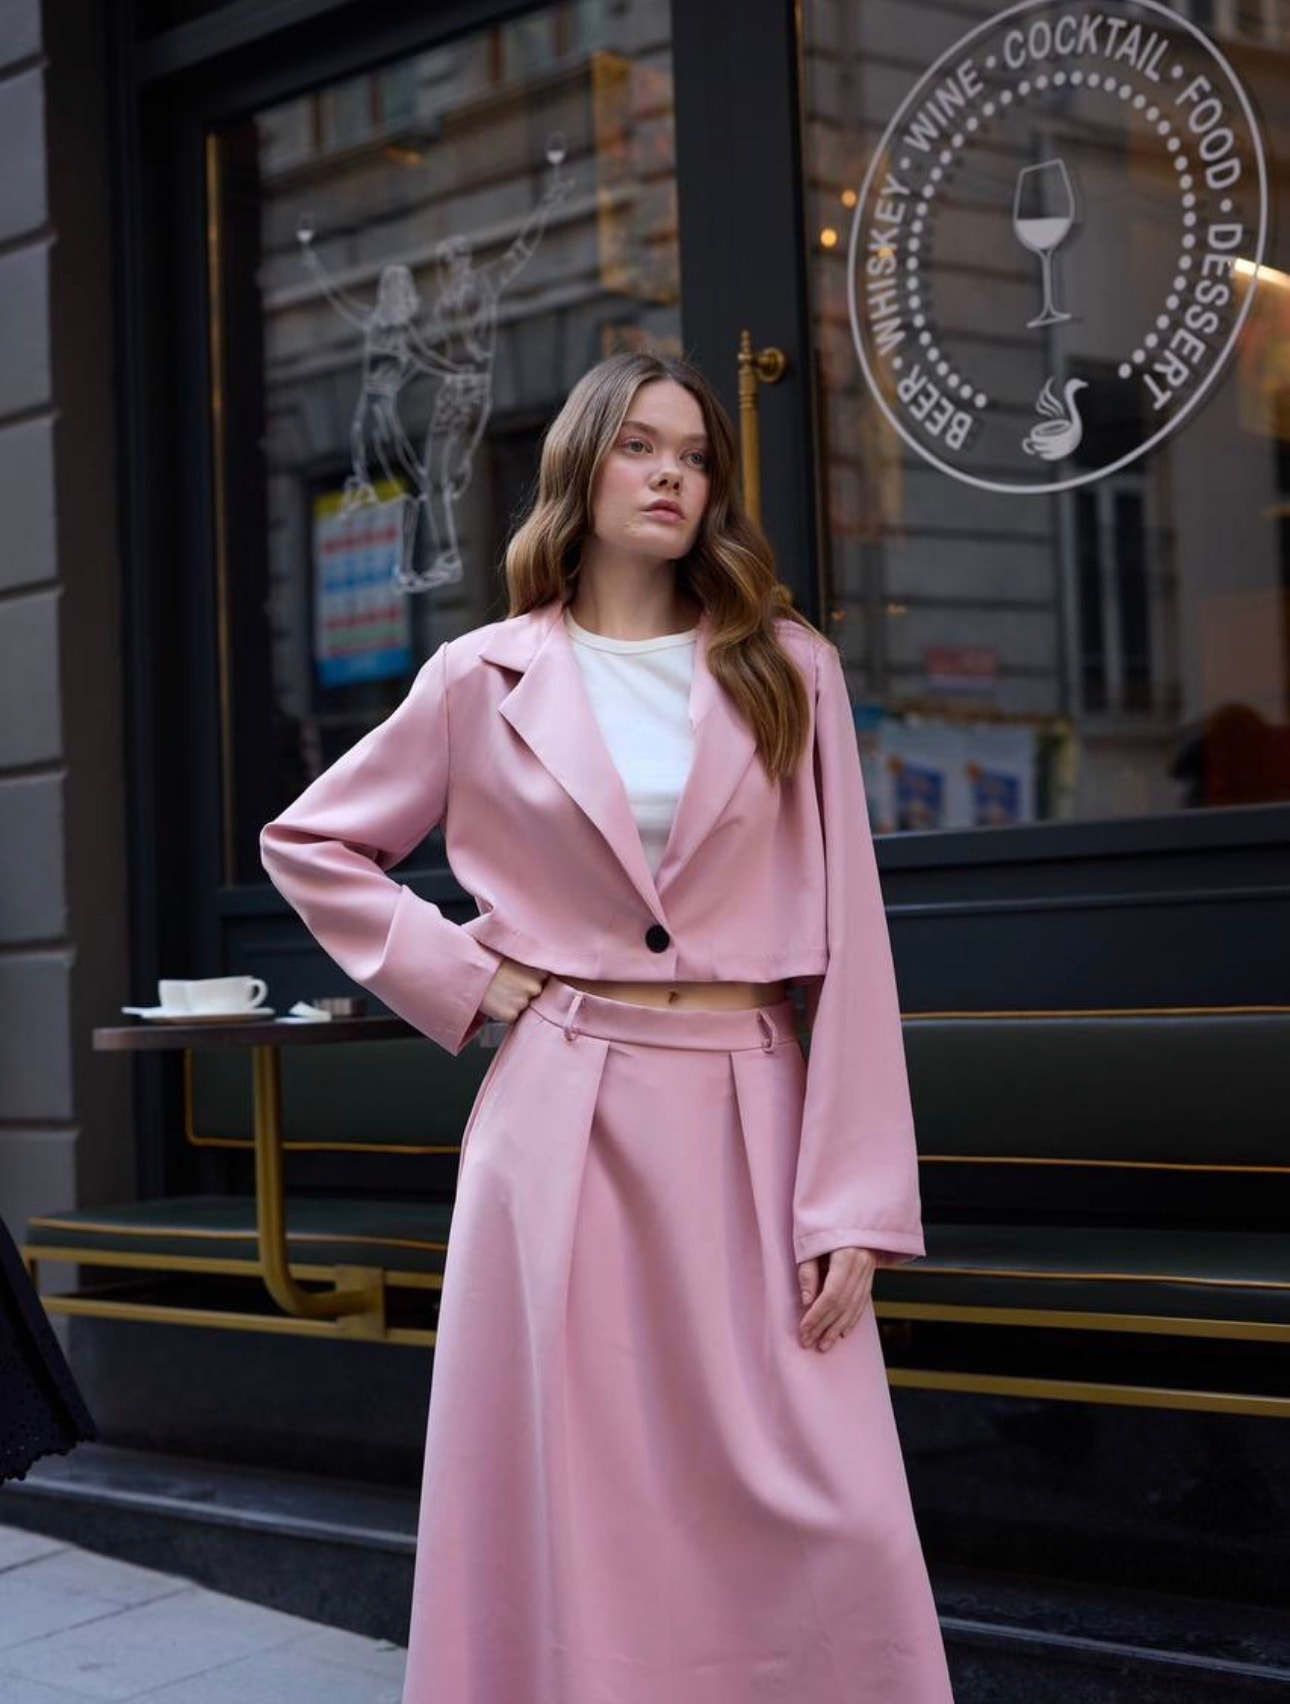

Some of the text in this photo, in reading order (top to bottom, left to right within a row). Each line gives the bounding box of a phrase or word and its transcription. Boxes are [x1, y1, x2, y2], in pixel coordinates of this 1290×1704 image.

[866, 13, 1244, 450] BEER WHISKEY WINE COCKTAIL FOOD DESSERT
